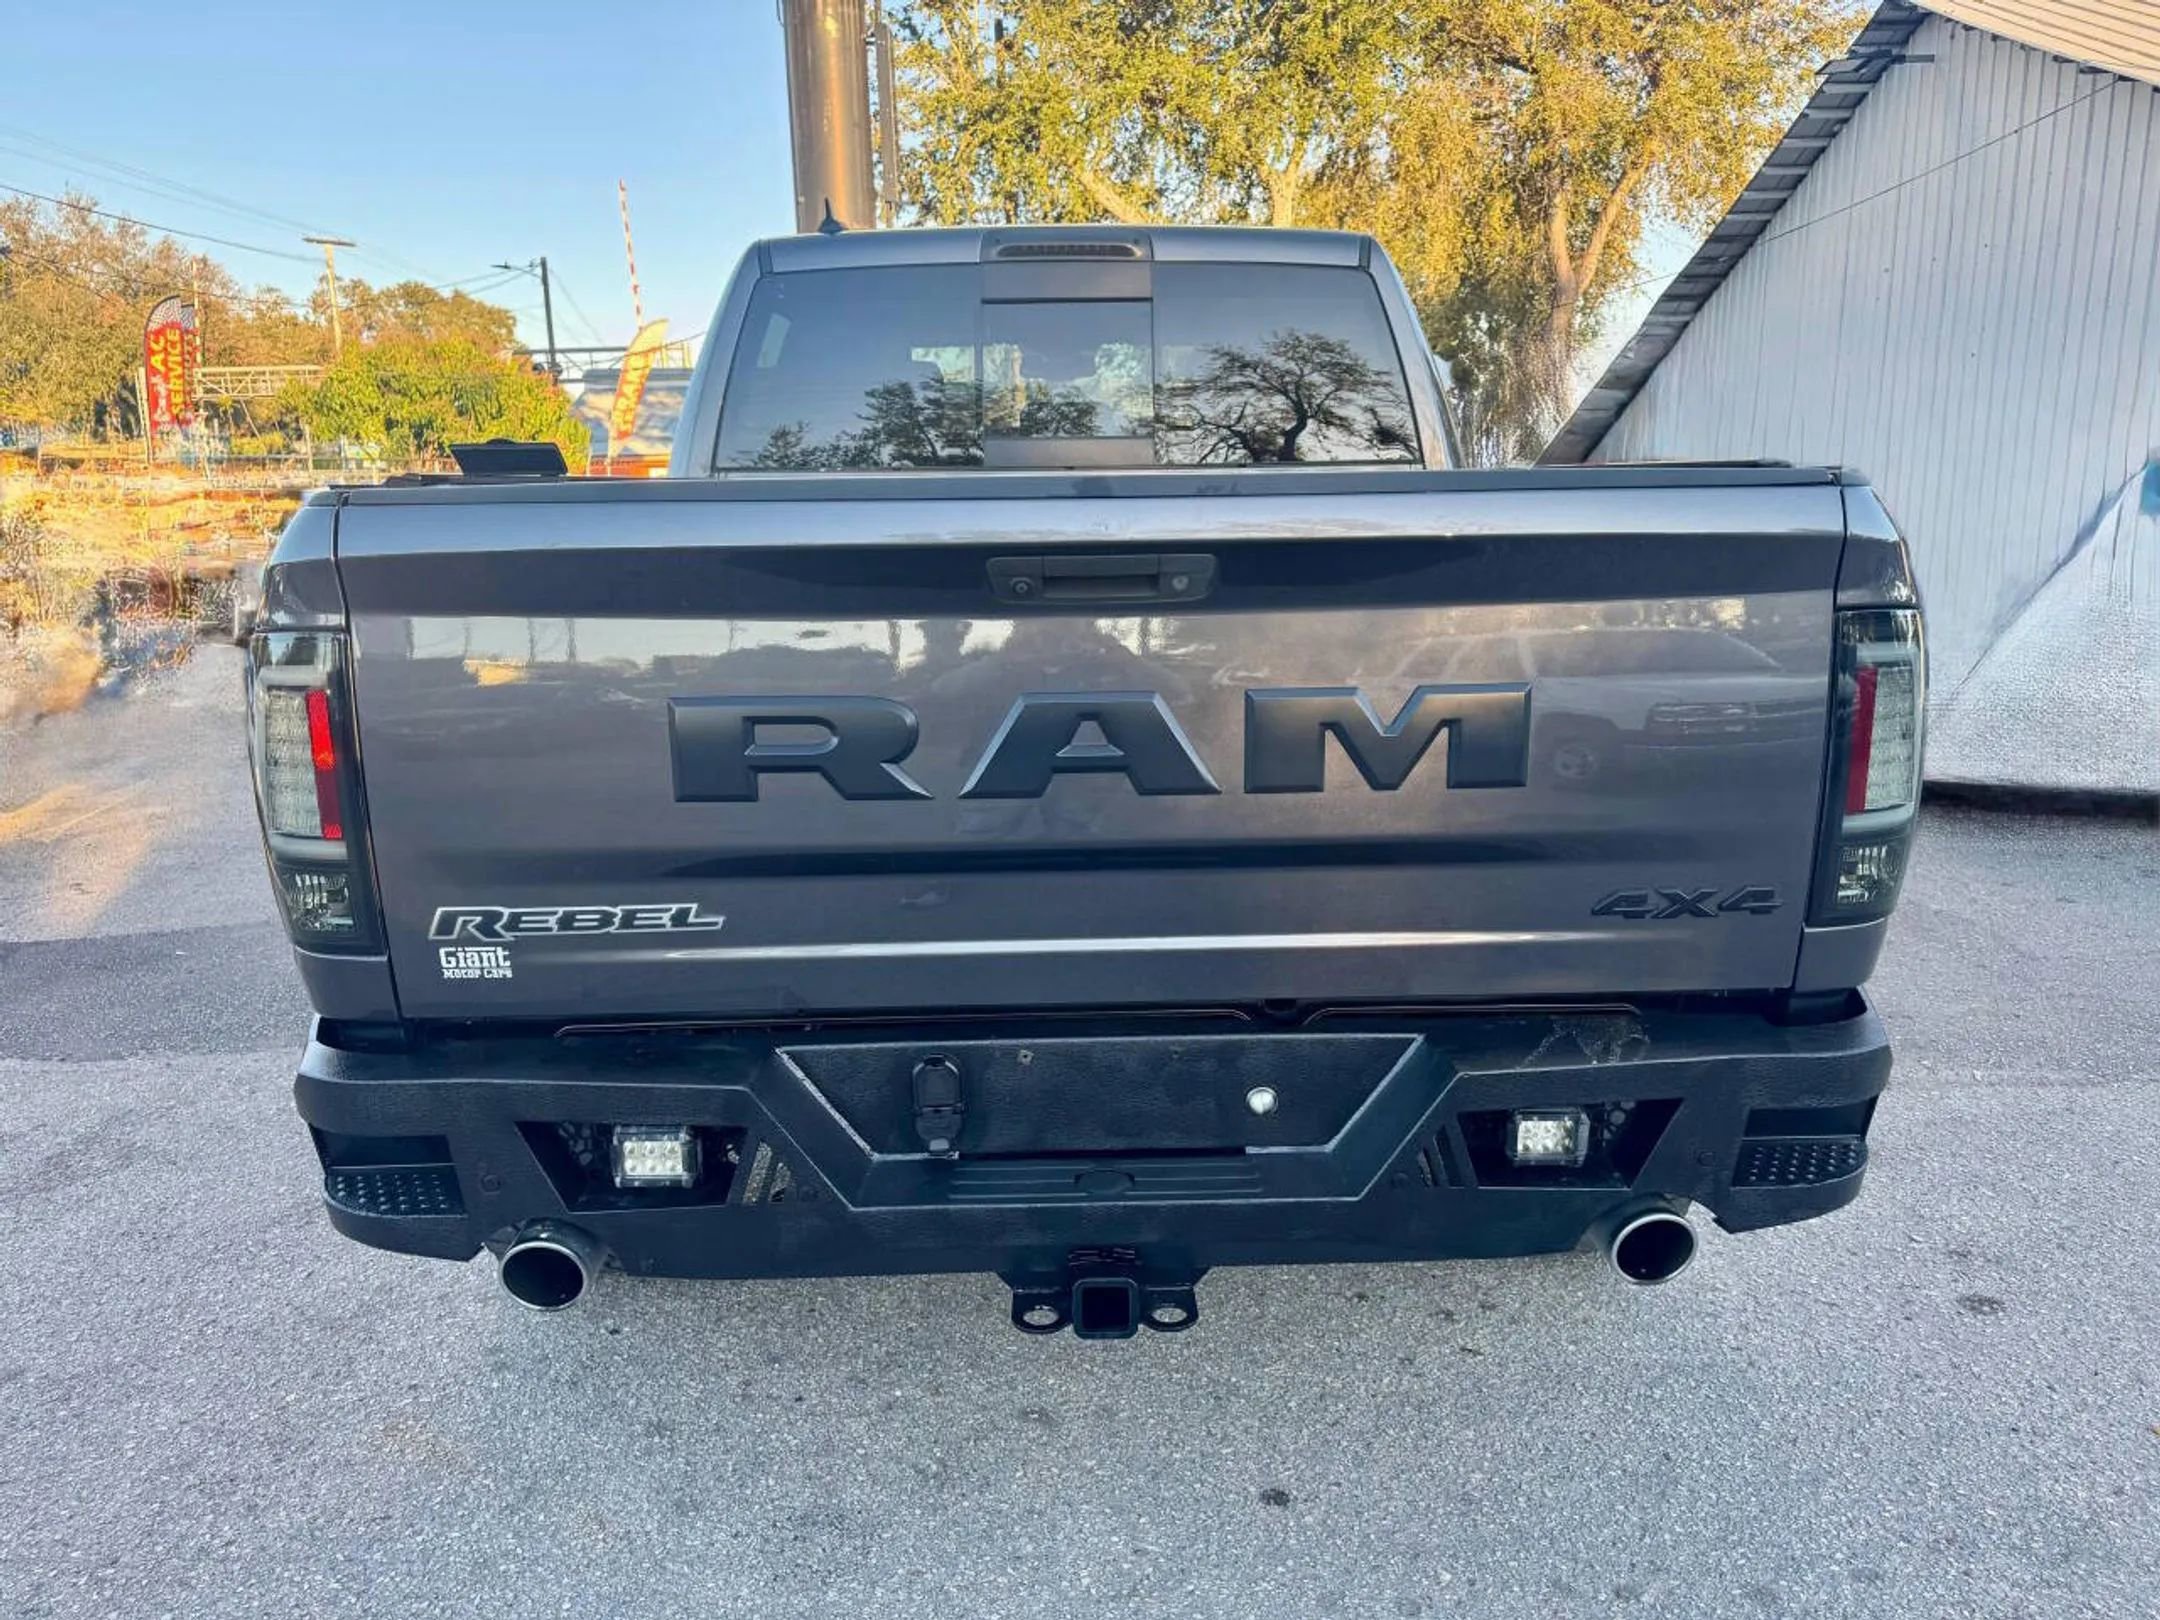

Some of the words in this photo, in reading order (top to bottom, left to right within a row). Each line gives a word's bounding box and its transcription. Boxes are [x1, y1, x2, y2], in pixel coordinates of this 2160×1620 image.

[151, 334, 166, 373] AC
[166, 328, 184, 416] SERVICE
[667, 681, 1532, 801] RAM
[428, 903, 726, 941] REBEL
[439, 946, 511, 968] Giant
